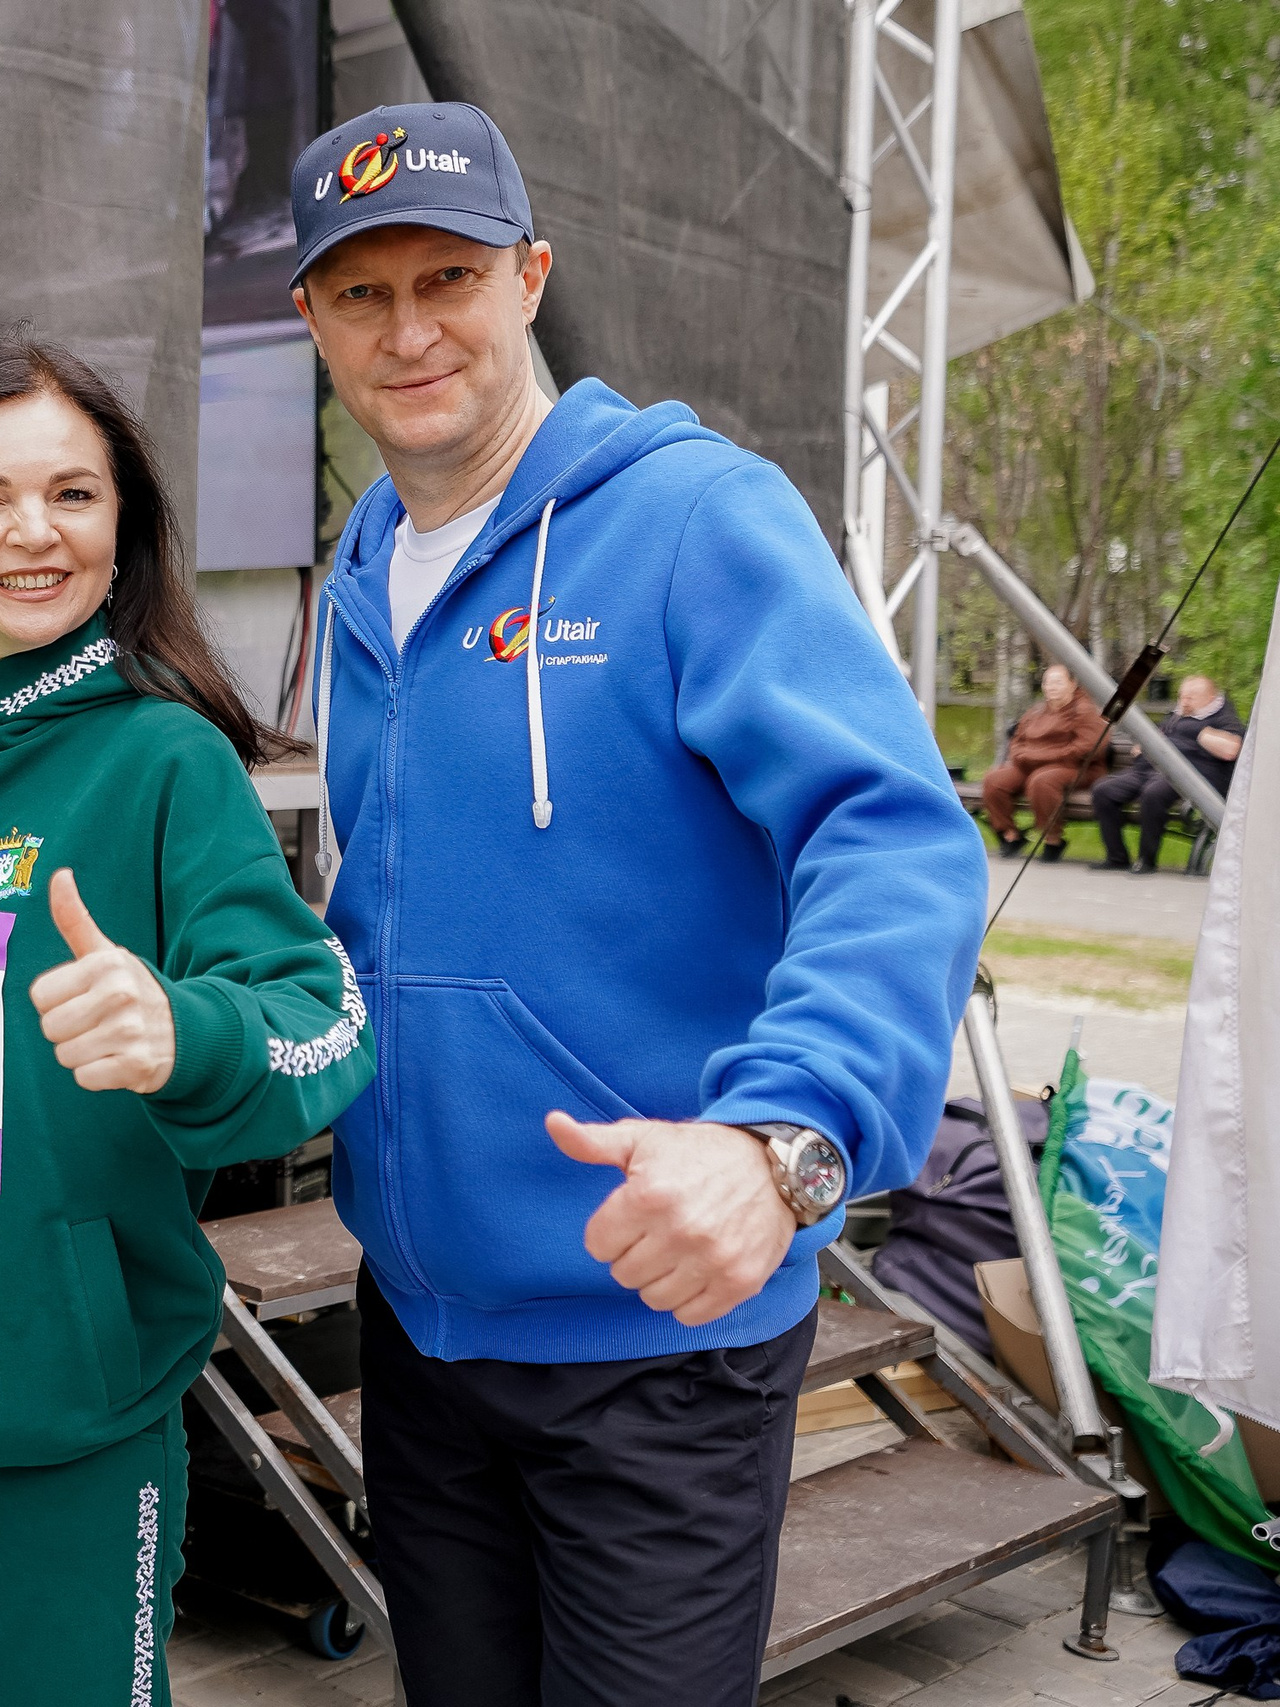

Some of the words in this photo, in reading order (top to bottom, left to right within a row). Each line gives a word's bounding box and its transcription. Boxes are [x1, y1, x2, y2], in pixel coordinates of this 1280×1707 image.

[405, 148, 470, 175] Utair
[543, 617, 601, 643] Utair
[545, 653, 609, 667] СПАРТАКИАДА
